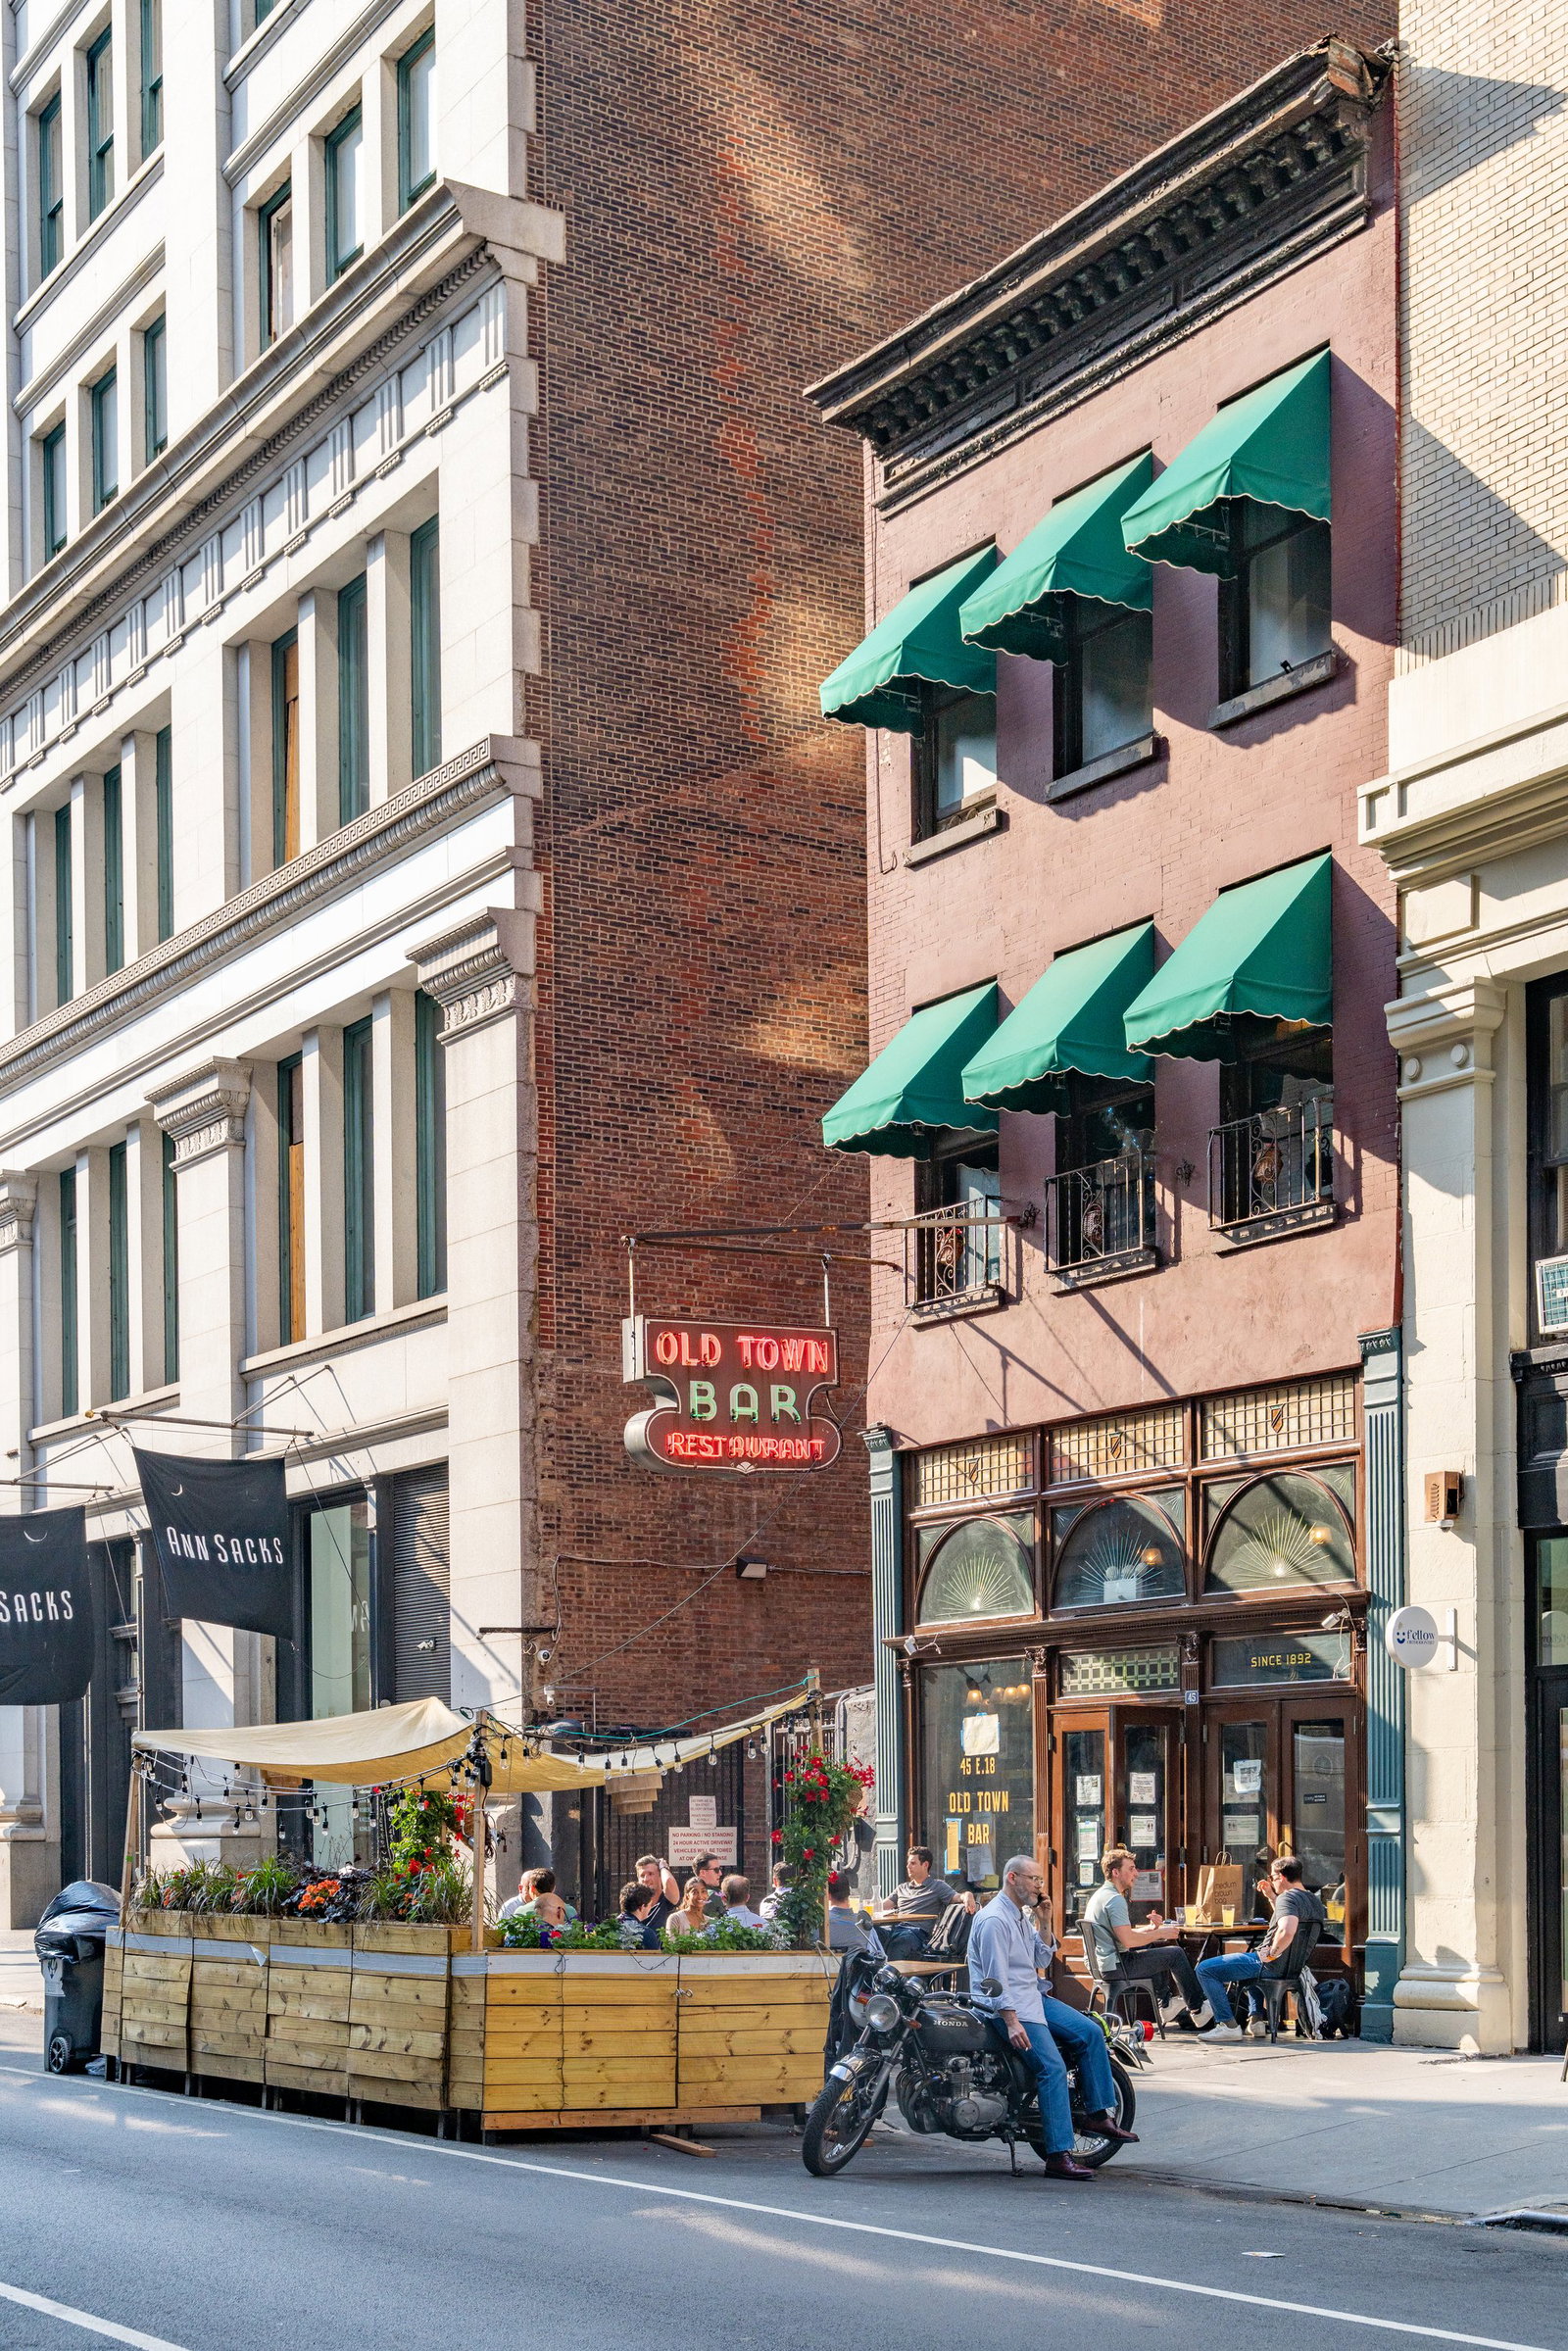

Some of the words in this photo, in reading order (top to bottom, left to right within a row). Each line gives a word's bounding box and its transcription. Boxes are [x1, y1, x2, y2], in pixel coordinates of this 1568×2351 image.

[656, 1331, 722, 1367] OLD
[737, 1335, 828, 1373] TOWN
[689, 1380, 802, 1424] BAR
[666, 1432, 825, 1459] RESTAURANT
[166, 1526, 210, 1561] ANN
[214, 1533, 284, 1565] SACKS
[1406, 1629, 1435, 1641] fellow
[1250, 1654, 1282, 1668] SINCE
[1286, 1652, 1311, 1665] 1892
[1187, 1692, 1197, 1702] 45
[959, 1757, 971, 1775] 45
[975, 1756, 996, 1775] E.18
[949, 1791, 971, 1813] OLD
[977, 1790, 1008, 1812] TOWN
[967, 1823, 990, 1844] BAR
